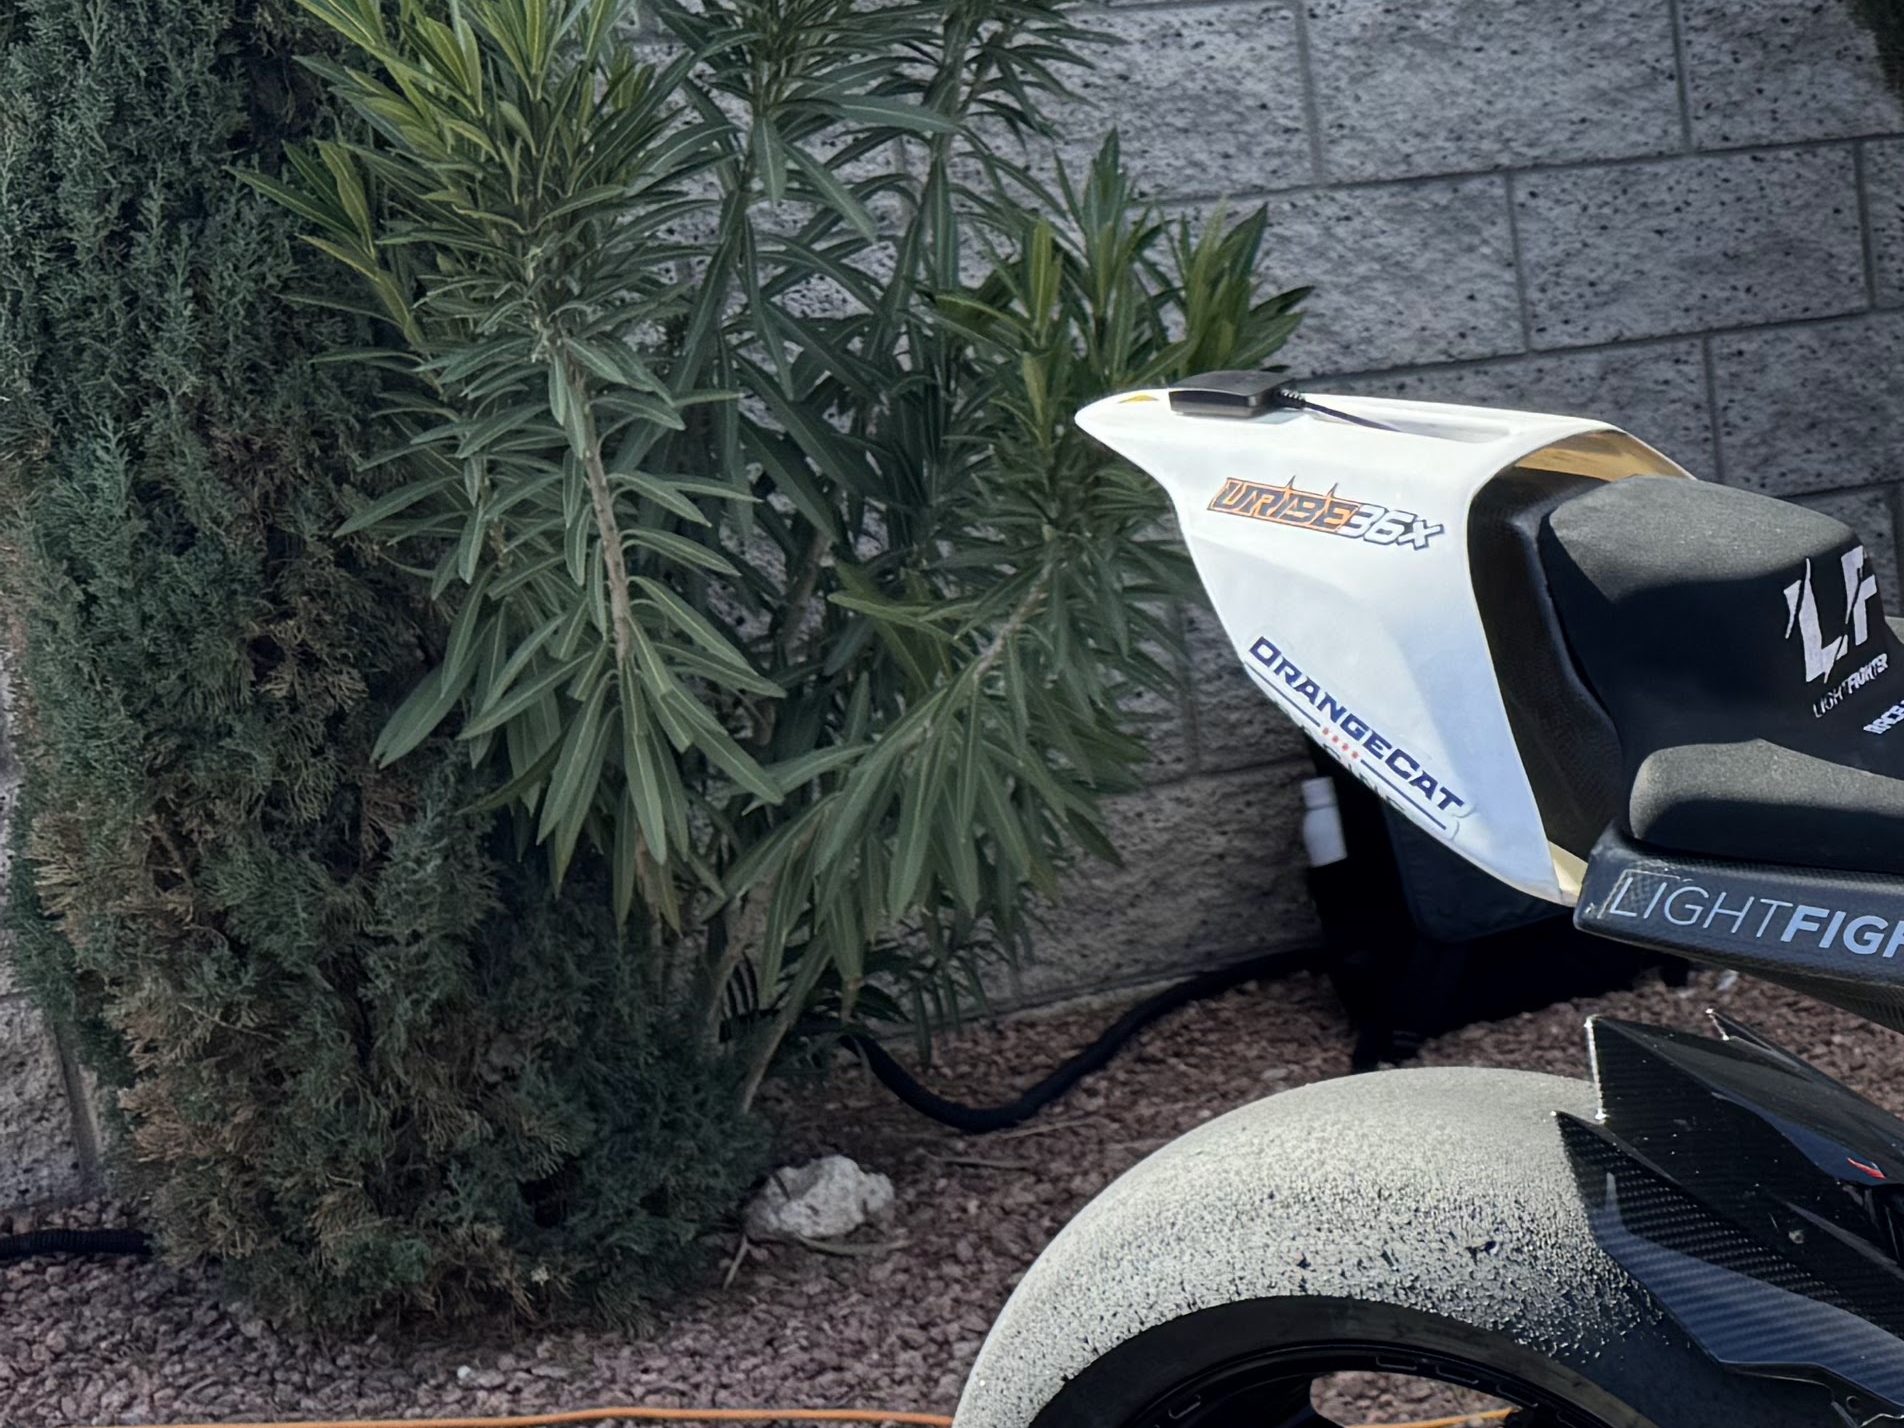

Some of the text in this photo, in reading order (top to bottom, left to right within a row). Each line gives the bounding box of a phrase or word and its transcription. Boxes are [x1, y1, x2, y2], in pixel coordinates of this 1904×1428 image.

[1783, 544, 1878, 685] LF
[1248, 635, 1465, 812] ORANGECAT
[1811, 652, 1890, 719] LIGHTFIGHTER
